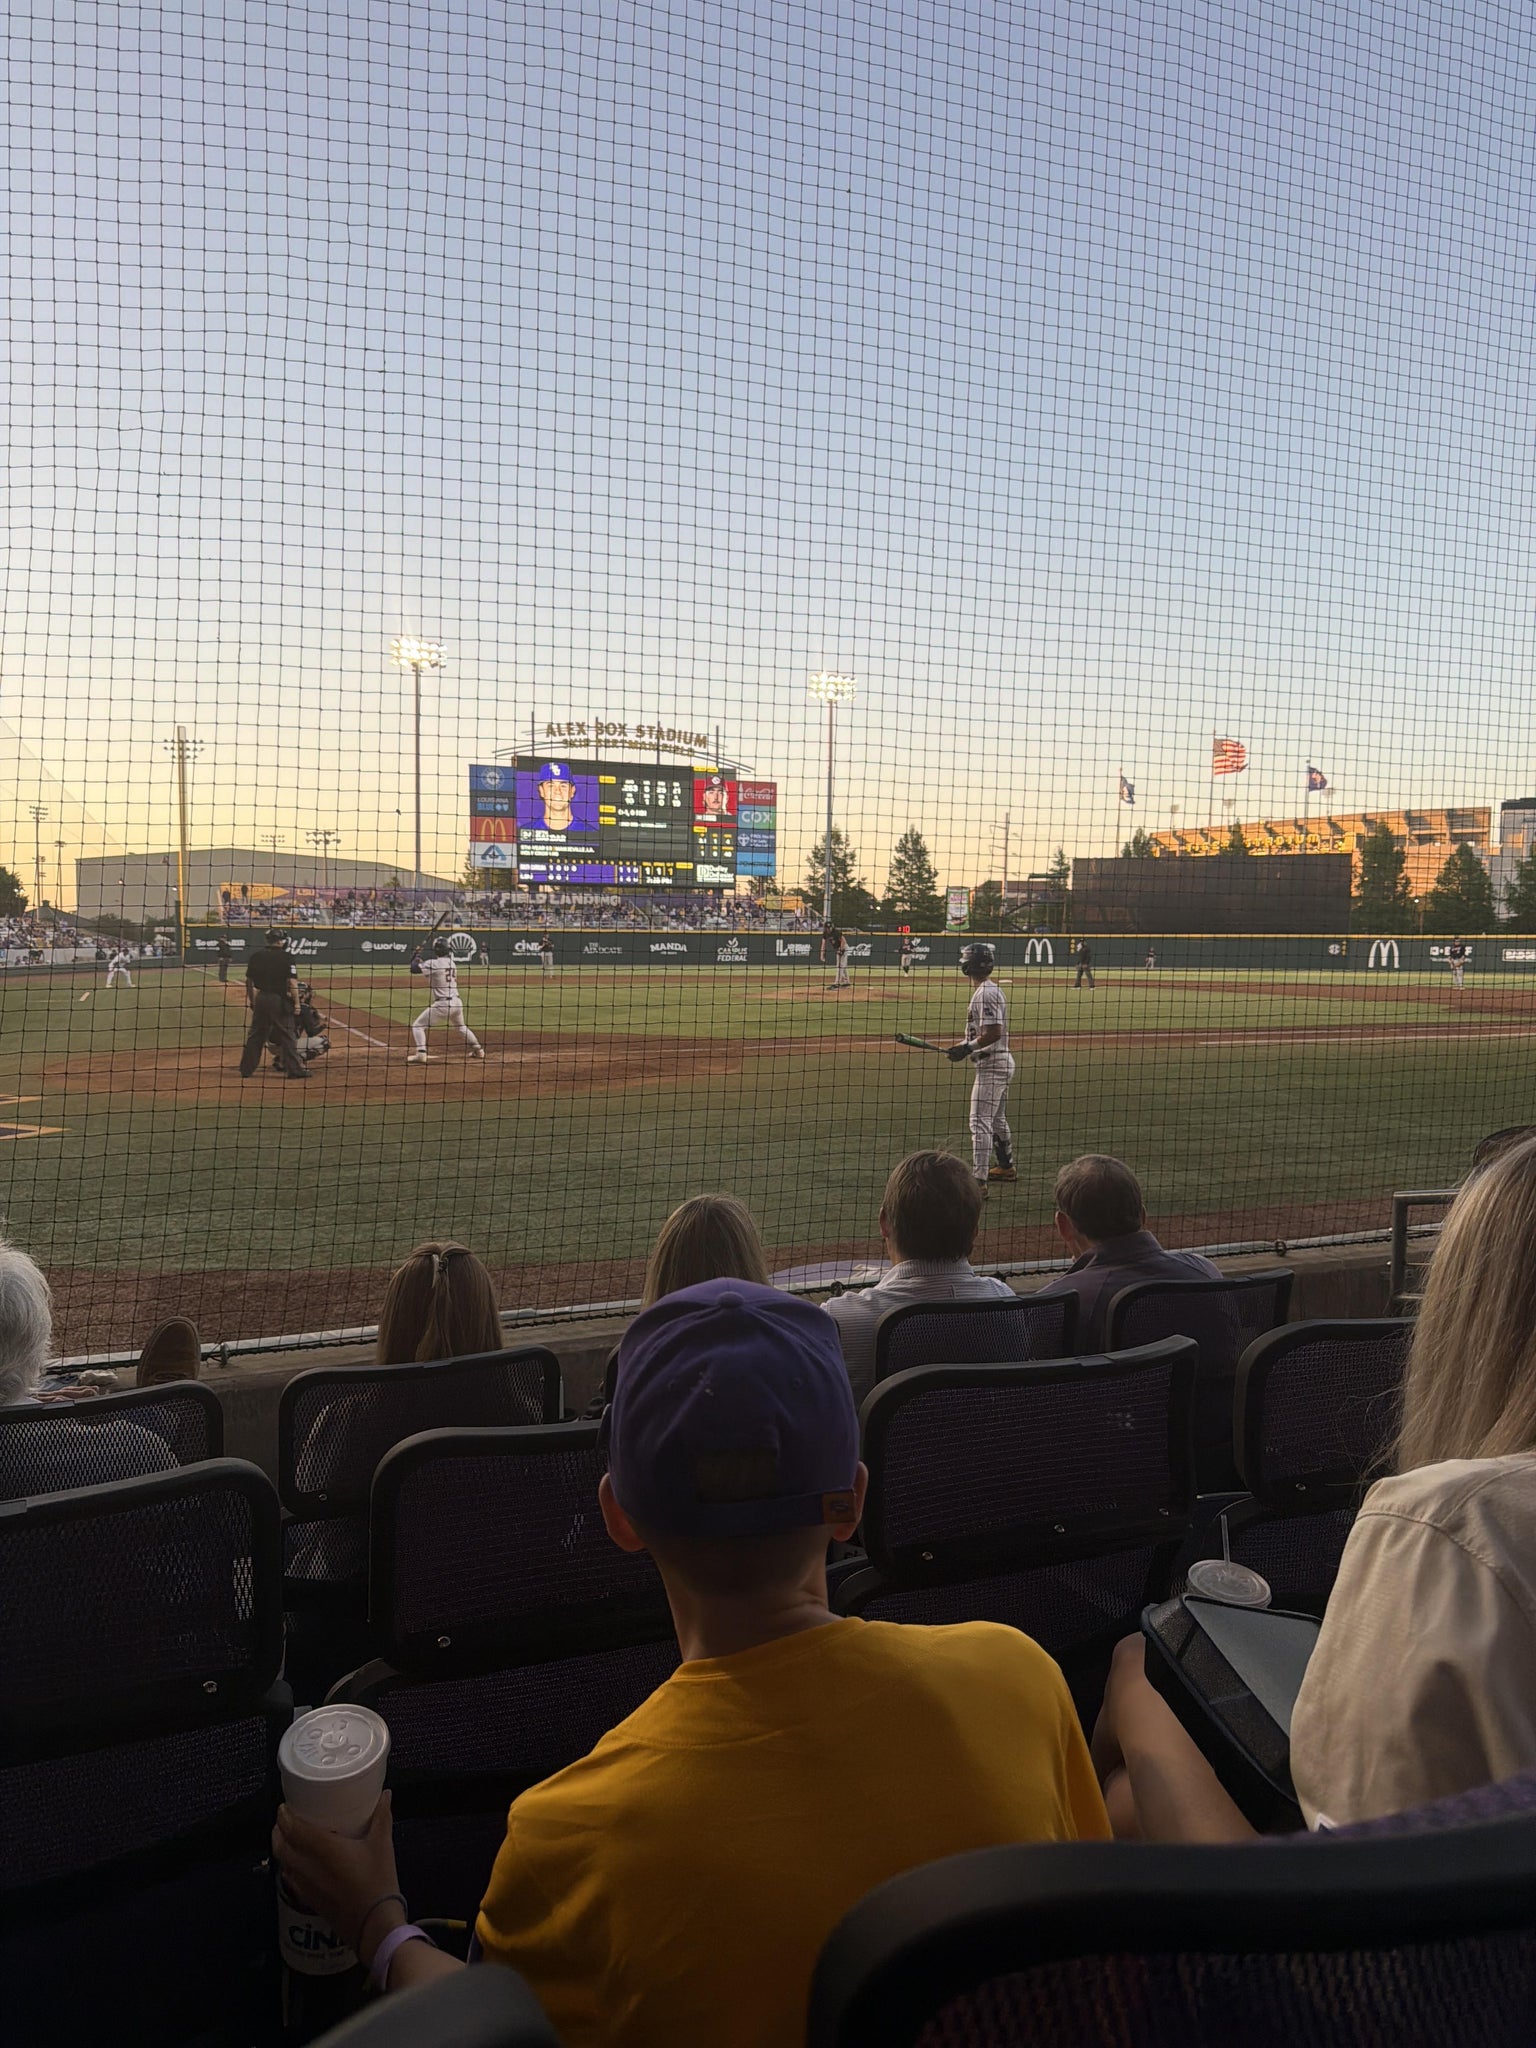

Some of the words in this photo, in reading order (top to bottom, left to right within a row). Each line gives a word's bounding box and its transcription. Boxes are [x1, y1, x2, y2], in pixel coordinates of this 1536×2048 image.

[546, 722, 587, 738] ALEX
[596, 722, 628, 738] BOX
[635, 724, 708, 749] STADIUM
[741, 811, 772, 823] COX
[549, 893, 621, 907] LANDING
[583, 945, 623, 954] ADVOCATE
[650, 942, 688, 952] MANDA
[717, 947, 748, 955] CAMPUS
